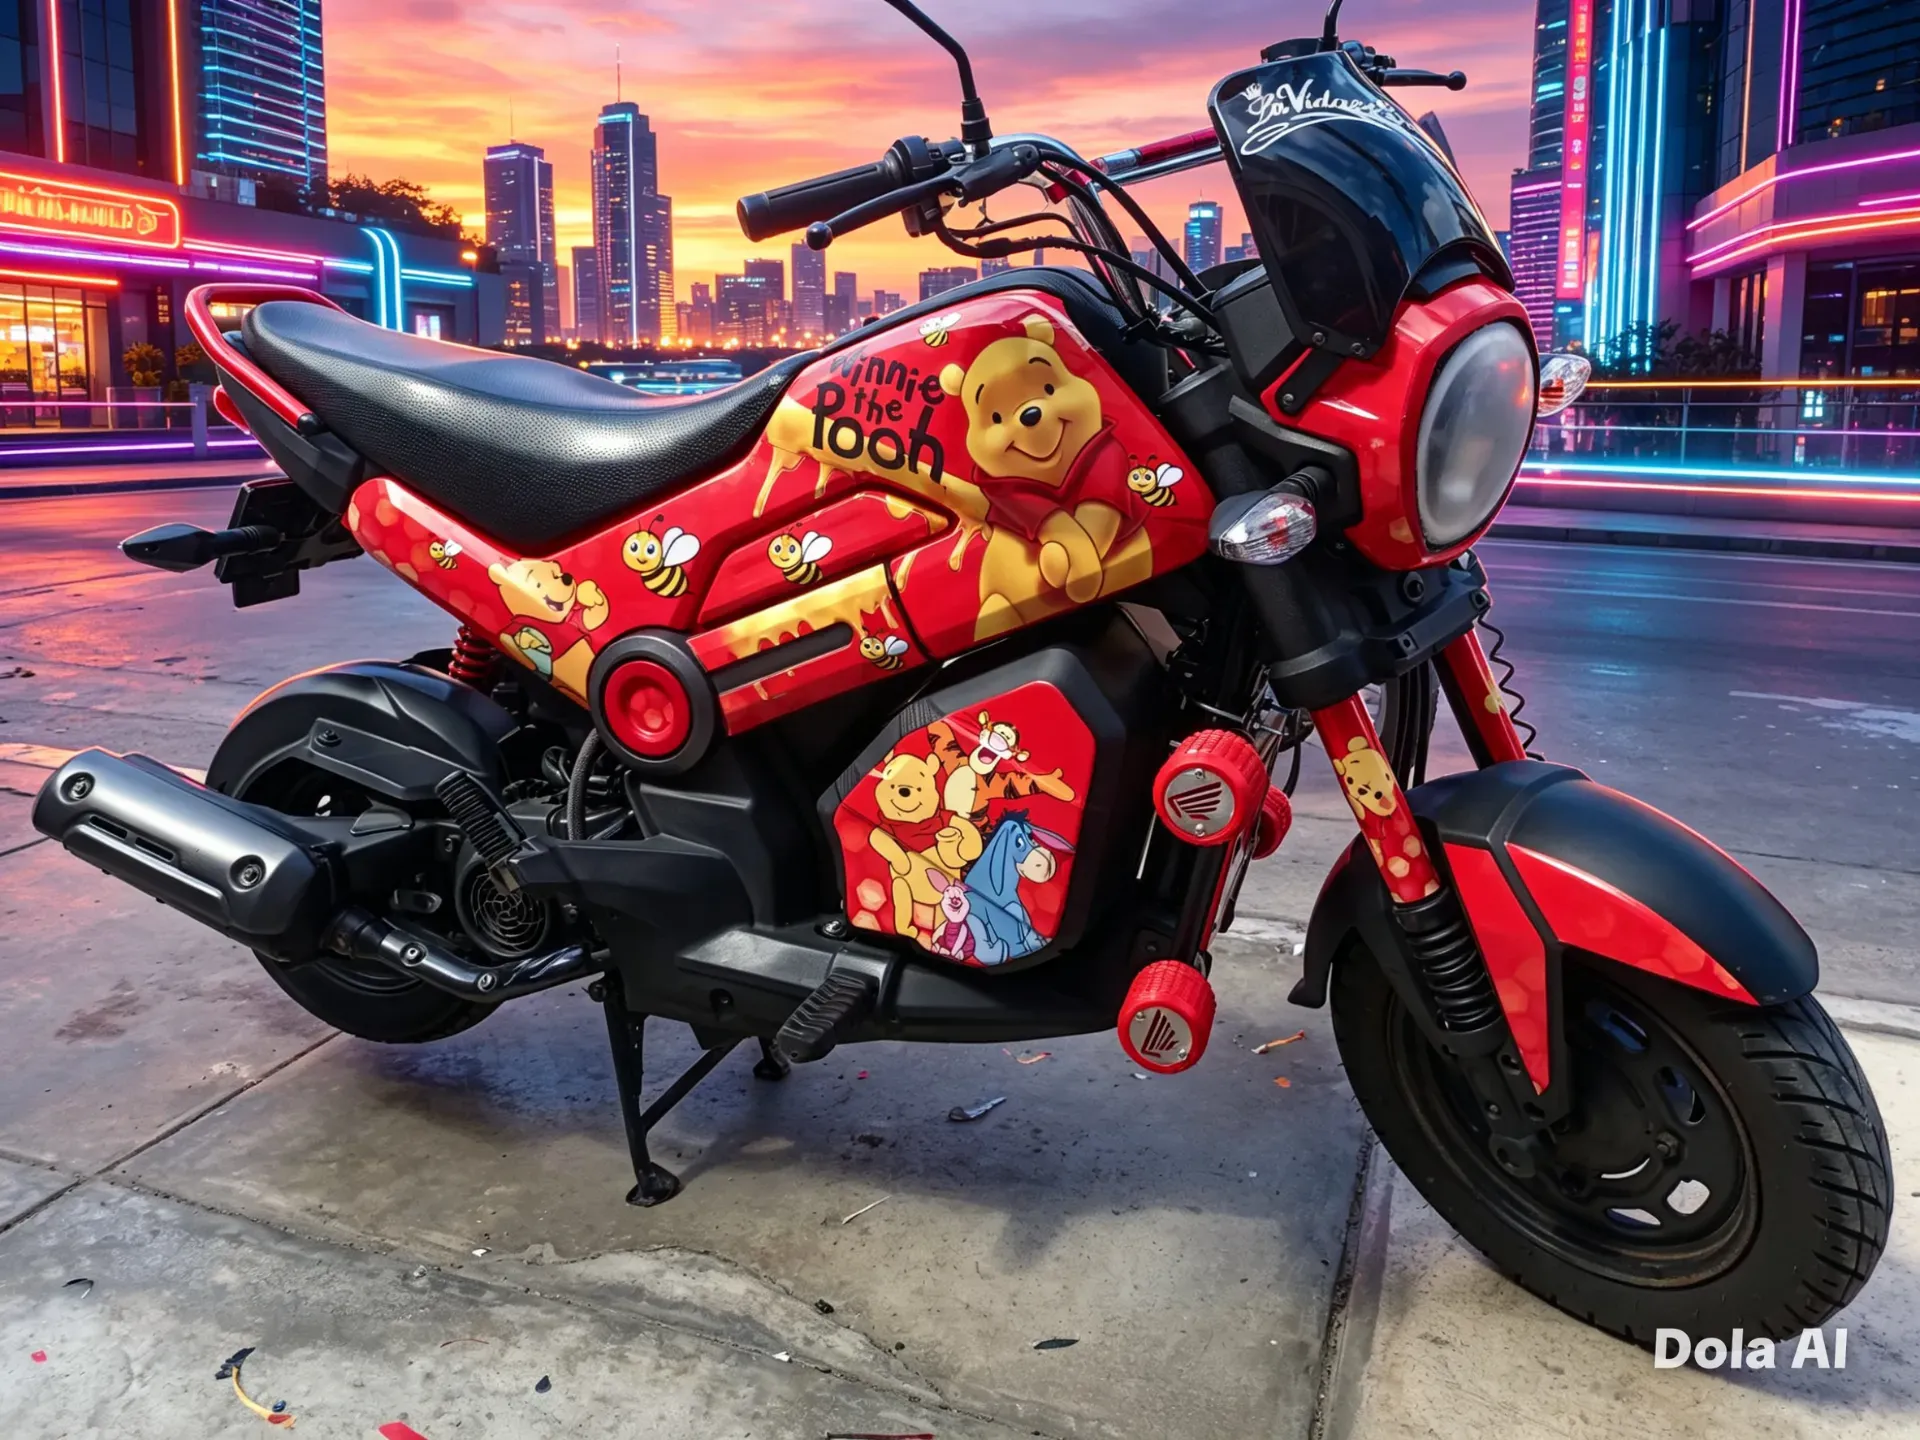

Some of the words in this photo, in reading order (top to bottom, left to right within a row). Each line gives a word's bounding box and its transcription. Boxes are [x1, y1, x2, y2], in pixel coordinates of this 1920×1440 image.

[830, 345, 946, 405] Winnie
[812, 381, 944, 484] Pooh
[854, 387, 903, 424] the
